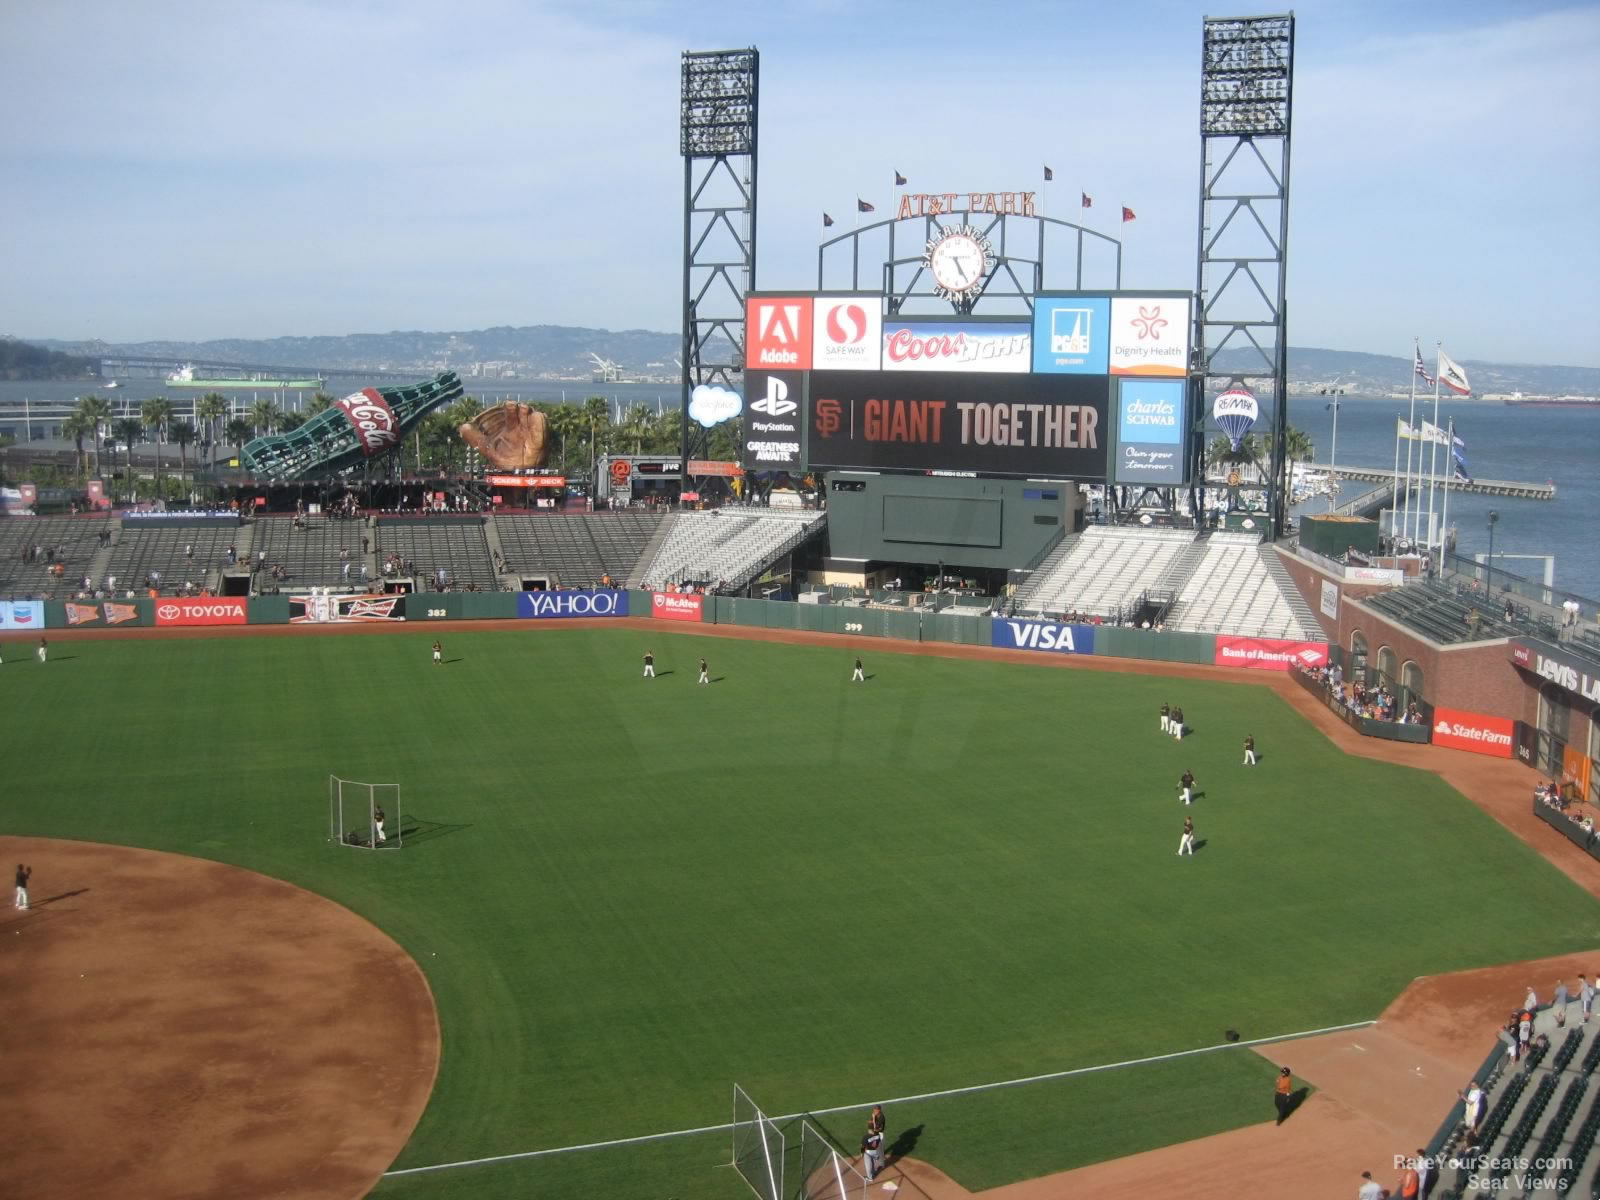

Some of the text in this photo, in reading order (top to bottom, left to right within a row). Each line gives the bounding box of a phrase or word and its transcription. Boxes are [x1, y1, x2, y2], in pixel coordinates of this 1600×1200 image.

[897, 191, 1035, 220] AT&T PARK
[920, 224, 998, 269] SAN FRANCISCO
[931, 282, 982, 302] GIANTS
[825, 345, 866, 355] SAFEWAY
[887, 328, 967, 361] Coors
[760, 348, 798, 363] Adobe
[1115, 346, 1182, 357] Dignity Health
[1127, 399, 1175, 414] charles
[1218, 398, 1253, 411] RE/MAX
[864, 400, 946, 442] GIANT
[957, 403, 1099, 448] TOGETHER
[1126, 415, 1175, 425] SCHWAB
[747, 441, 799, 452] GREATNESS
[662, 463, 680, 472] jive
[540, 476, 561, 485] DECK
[350, 602, 394, 612] Budweiser
[528, 593, 618, 616] YAHOO!
[665, 598, 699, 608] McAfee
[183, 605, 244, 617] TOYOTA
[845, 622, 862, 631] 399
[1007, 622, 1075, 650] VISA
[1223, 647, 1296, 662] Bank of America
[1520, 745, 1530, 759] 365
